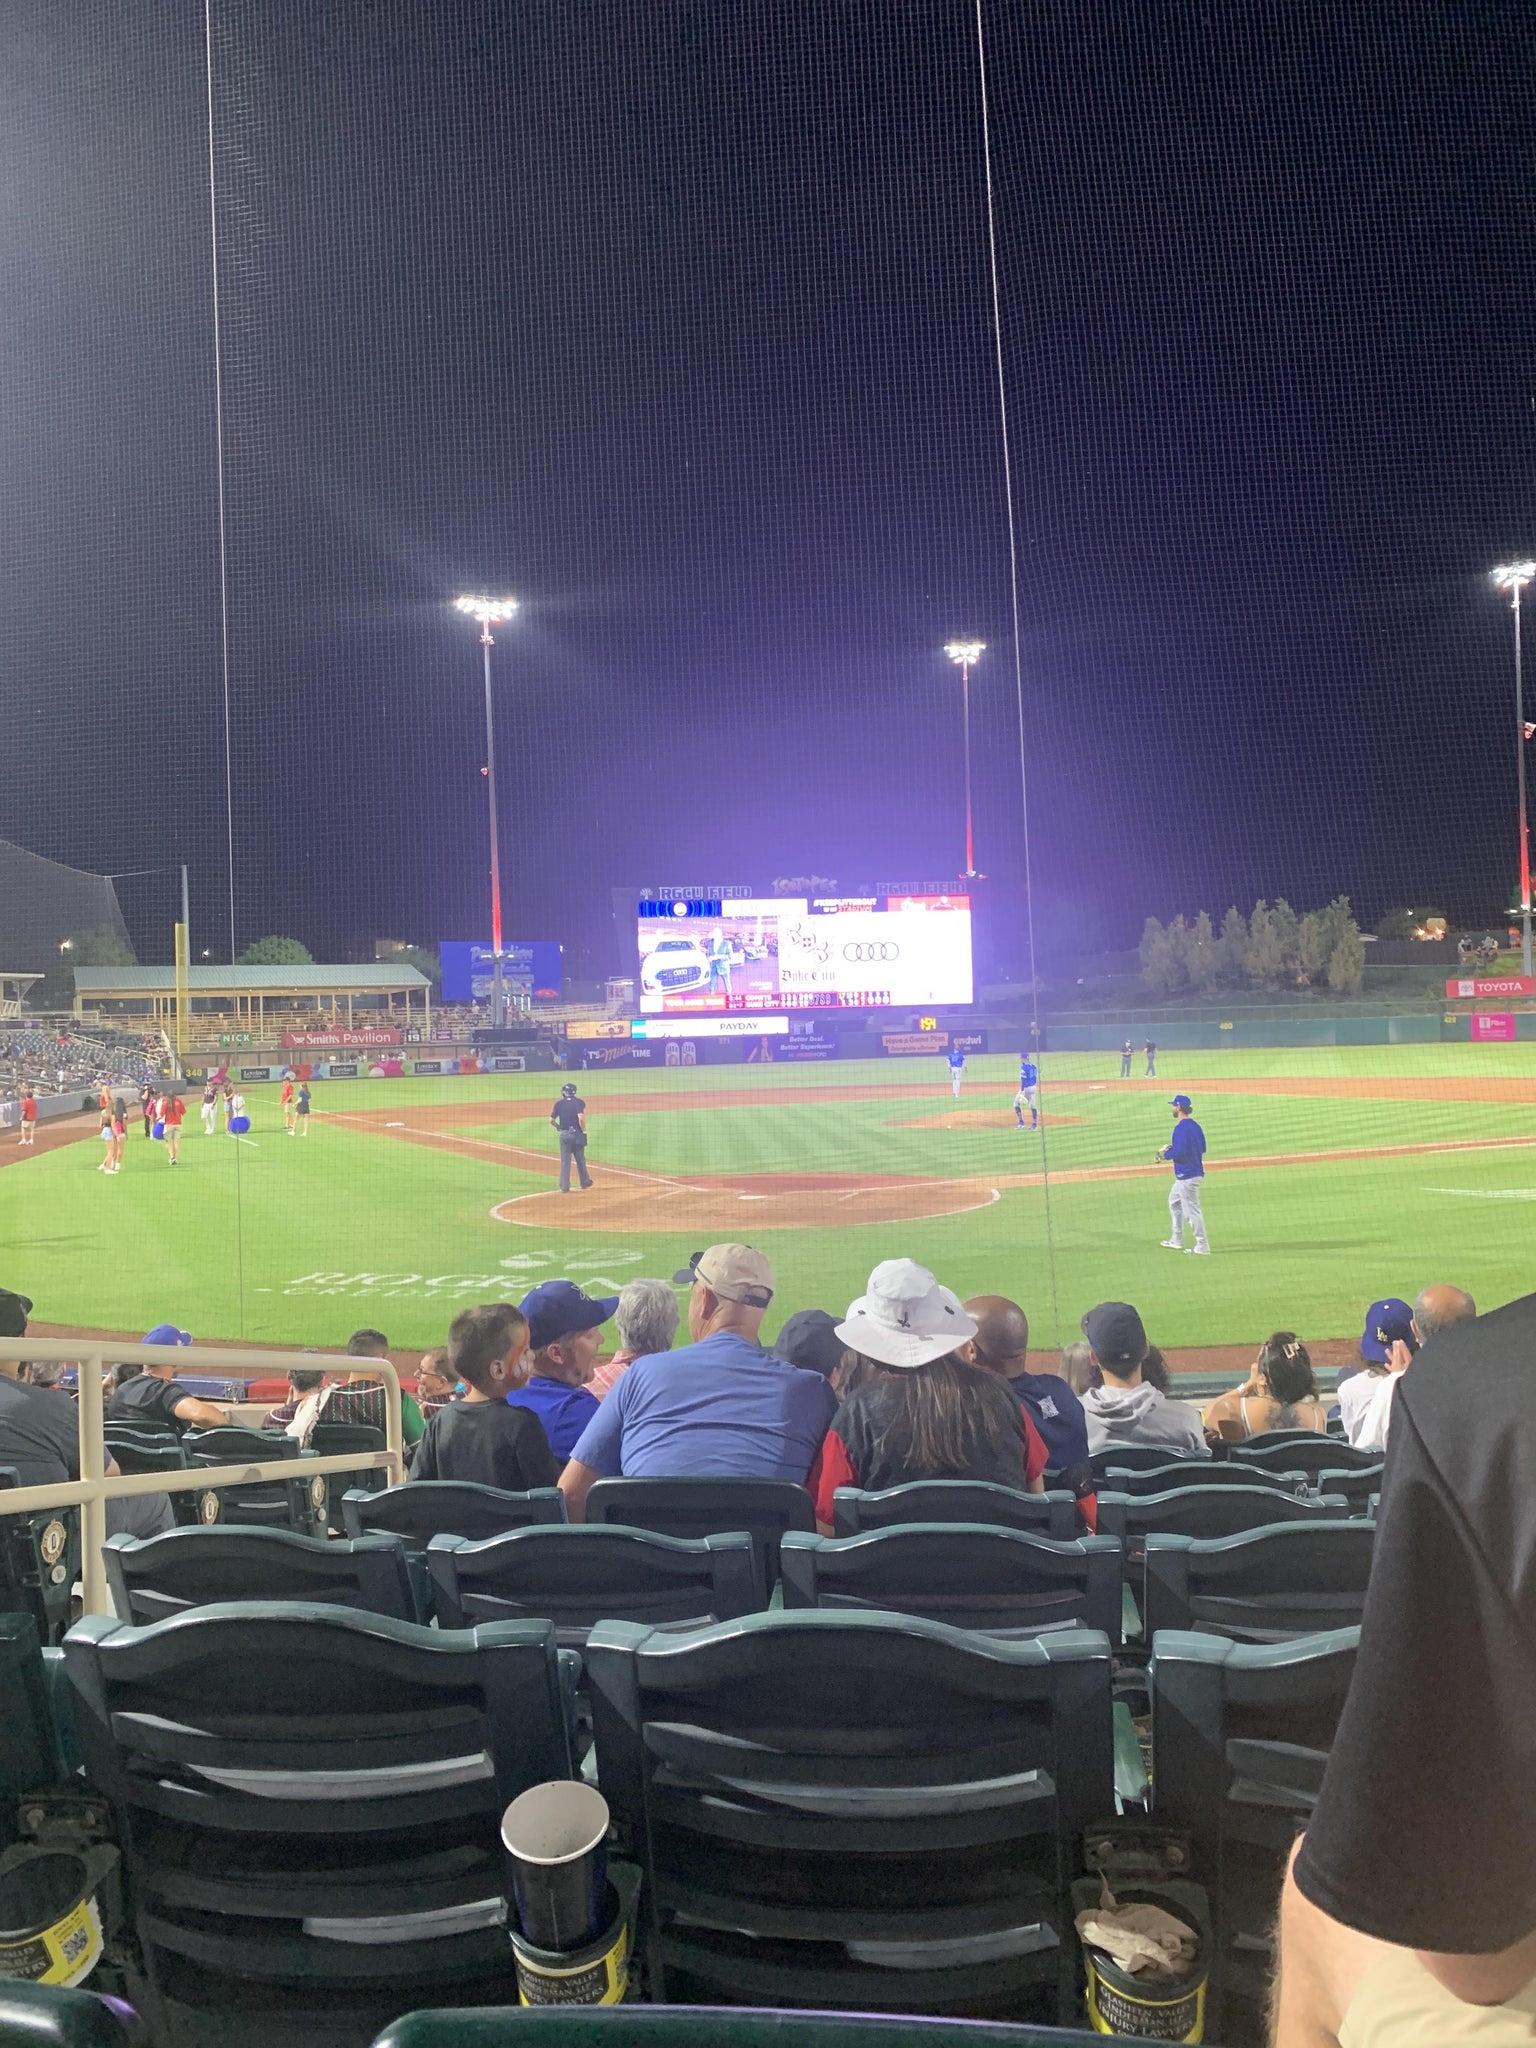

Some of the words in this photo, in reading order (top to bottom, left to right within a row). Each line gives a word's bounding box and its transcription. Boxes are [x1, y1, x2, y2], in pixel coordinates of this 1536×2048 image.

[659, 886, 703, 900] RGCU
[707, 886, 752, 899] FIELD
[1477, 982, 1522, 992] TOYOTA
[720, 1021, 759, 1030] PAYDAY
[222, 1034, 250, 1042] NICK
[306, 1033, 340, 1045] Smith's
[343, 1033, 391, 1044] Pavilion
[407, 1034, 420, 1042] 19
[632, 1049, 651, 1058] TIME
[185, 1069, 202, 1077] 340
[283, 1271, 423, 1286] RIO
[553, 1986, 605, 2006] LAWYERS
[1098, 2000, 1138, 2033] INJURY
[1142, 2020, 1193, 2038] LAWYERS
